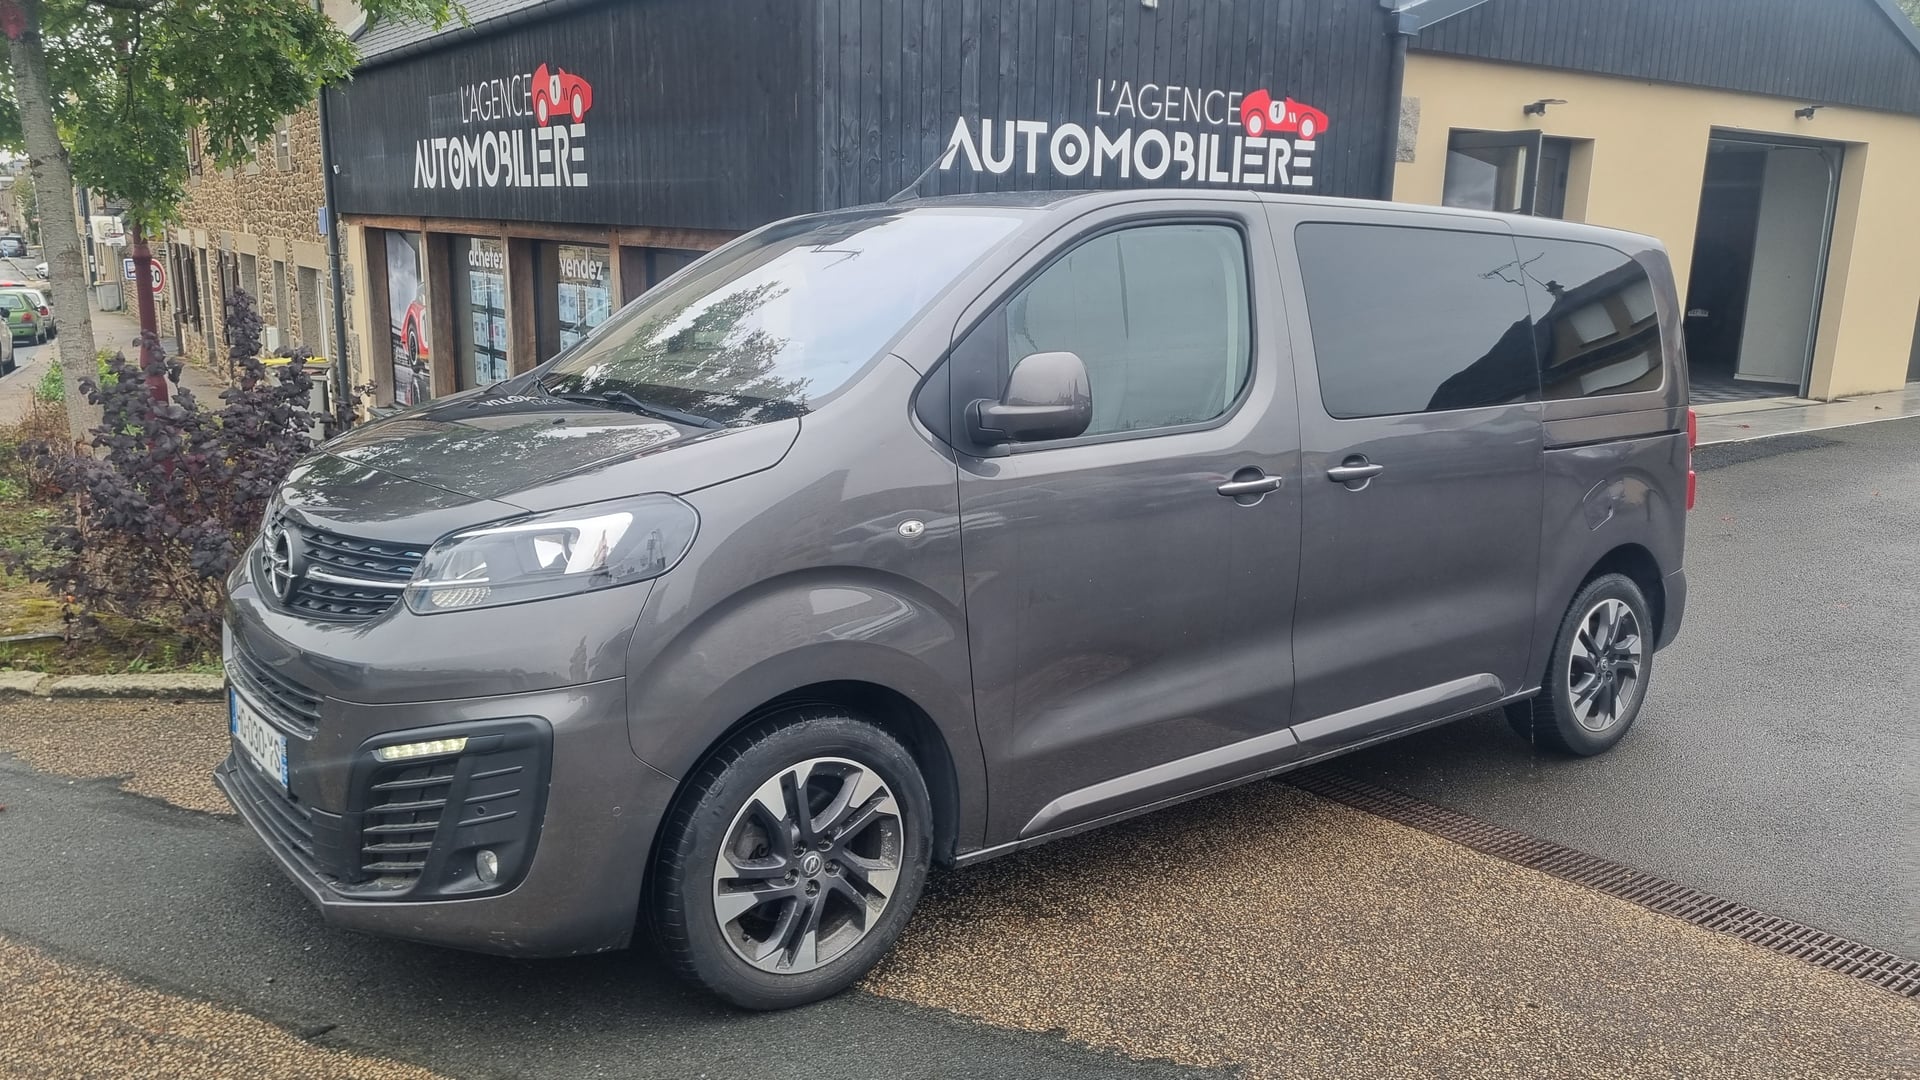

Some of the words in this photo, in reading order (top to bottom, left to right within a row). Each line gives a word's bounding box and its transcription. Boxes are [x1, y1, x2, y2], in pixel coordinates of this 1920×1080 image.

[461, 74, 533, 123] L'AGENCE
[552, 79, 558, 99] 1
[1096, 78, 1244, 126] L'AGENCE
[1275, 103, 1280, 118] 1
[469, 241, 503, 269] achetez
[560, 248, 603, 280] vendez
